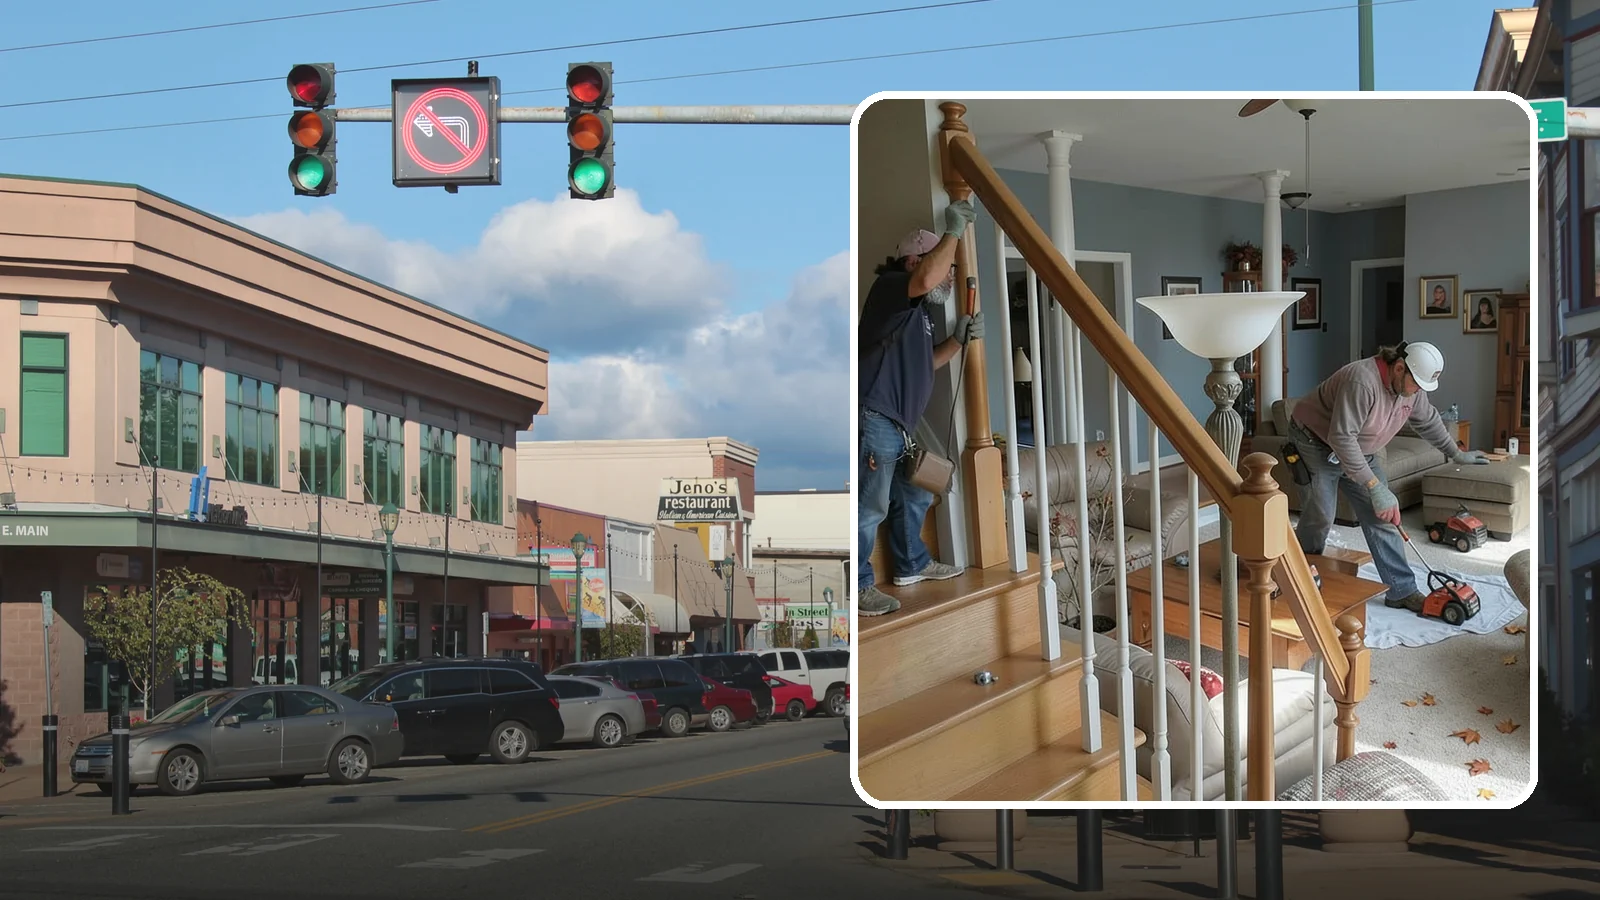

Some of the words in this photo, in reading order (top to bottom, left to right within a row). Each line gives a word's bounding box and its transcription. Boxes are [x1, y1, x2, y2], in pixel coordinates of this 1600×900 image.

[669, 480, 727, 495] Jeno's
[665, 496, 731, 509] restaurant
[658, 509, 682, 520] Italian
[686, 509, 715, 520] American
[715, 509, 738, 520] Cuisine
[2, 525, 13, 536] E.
[15, 525, 49, 536] MAIN
[797, 607, 829, 617] Street
[790, 619, 824, 627] lass
